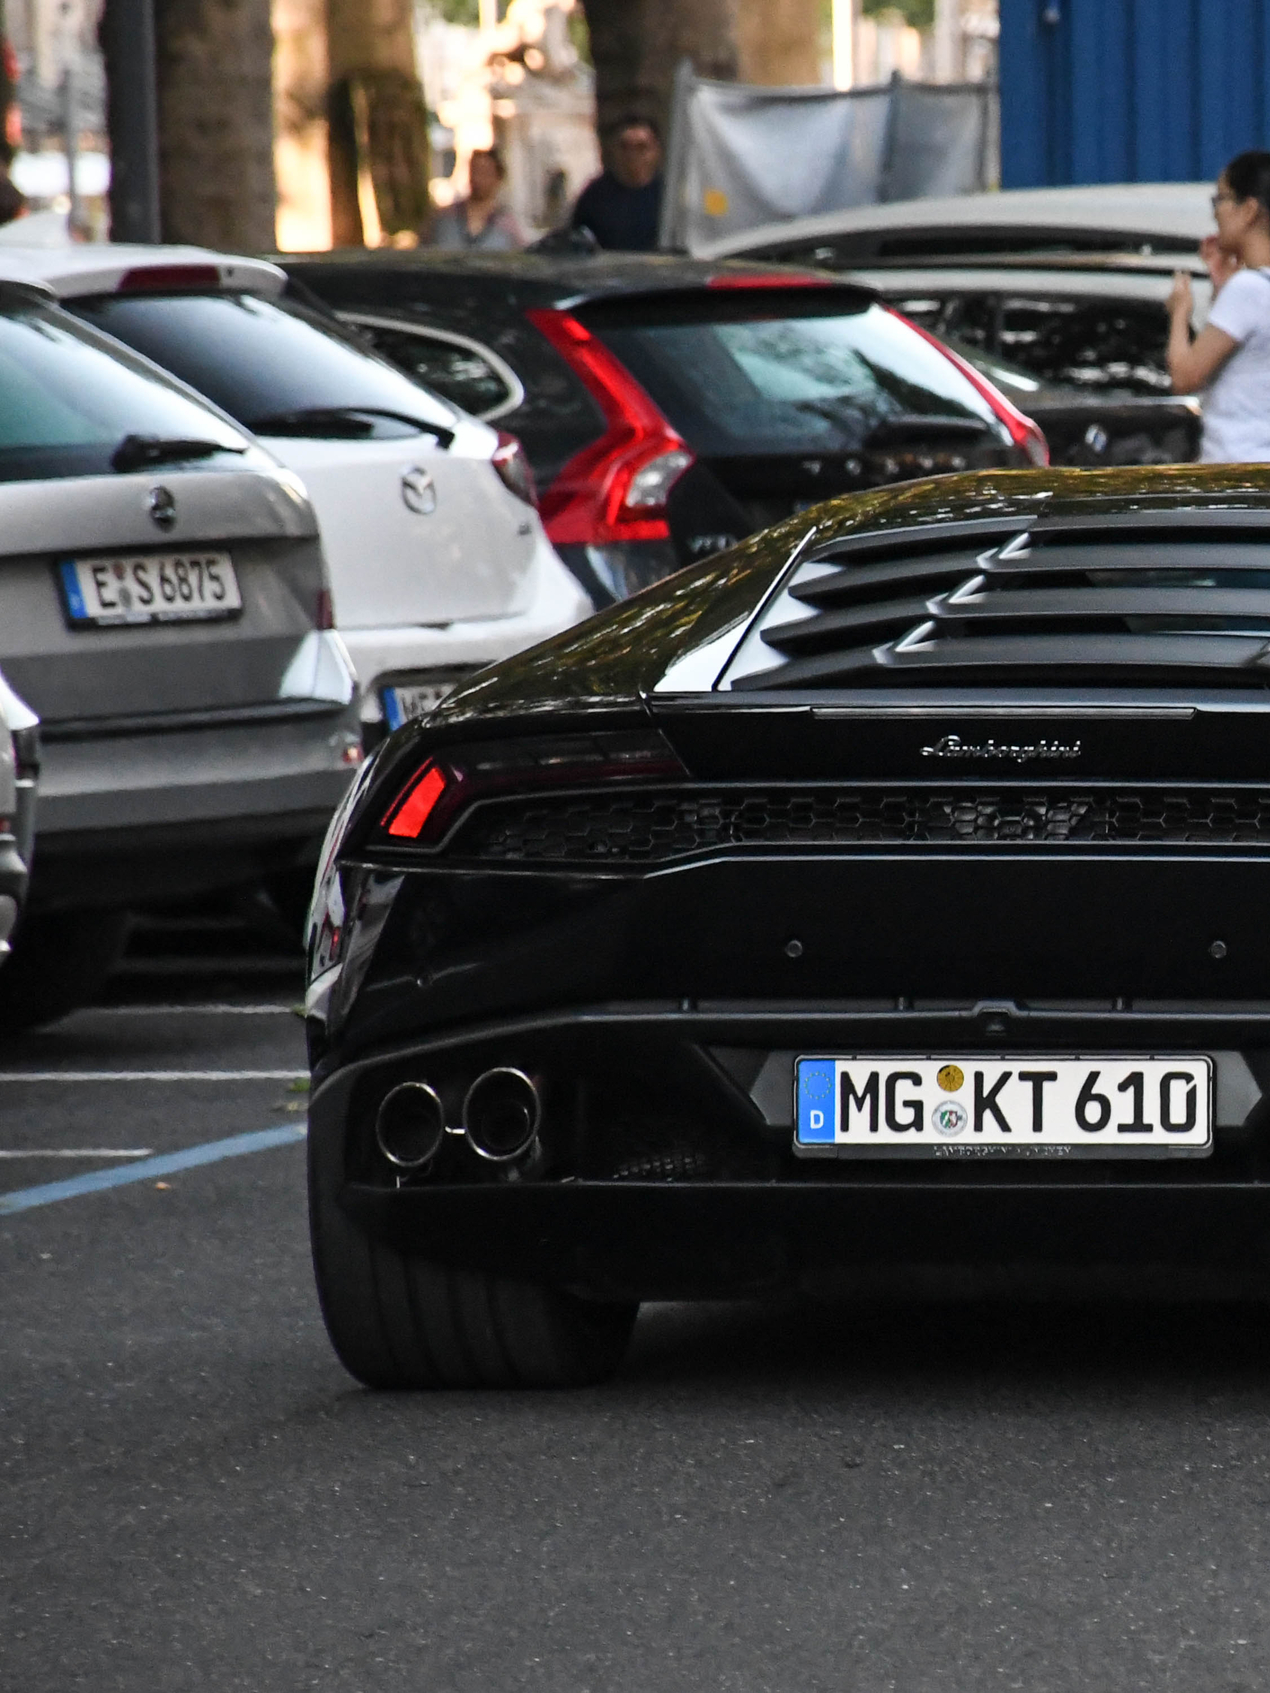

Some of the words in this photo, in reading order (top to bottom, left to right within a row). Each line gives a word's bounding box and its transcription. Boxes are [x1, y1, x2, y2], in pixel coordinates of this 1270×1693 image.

[92, 564, 116, 608] E
[132, 561, 154, 605] S
[158, 556, 226, 604] 6875
[810, 1110, 824, 1129] D
[840, 1070, 924, 1133] MG
[973, 1070, 1058, 1133] KT
[1074, 1070, 1198, 1133] 610
